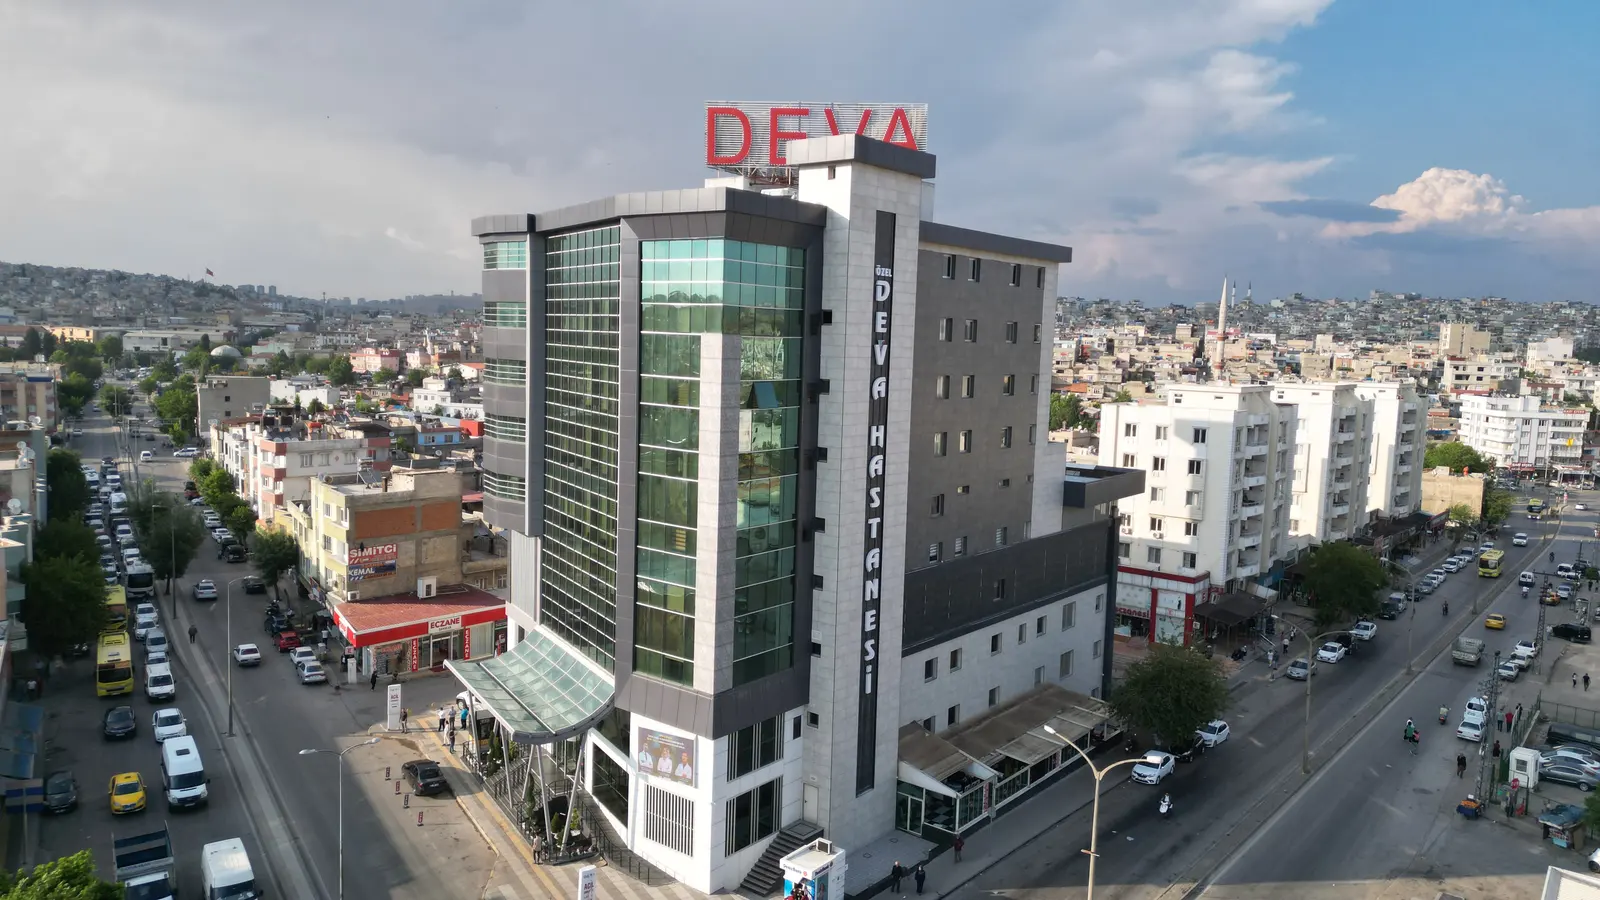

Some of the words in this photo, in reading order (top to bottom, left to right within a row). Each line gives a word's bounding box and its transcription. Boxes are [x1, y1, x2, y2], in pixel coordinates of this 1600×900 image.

[876, 265, 892, 277] ÖZEL
[872, 280, 890, 400] DEVA
[430, 617, 460, 629] ECZANE
